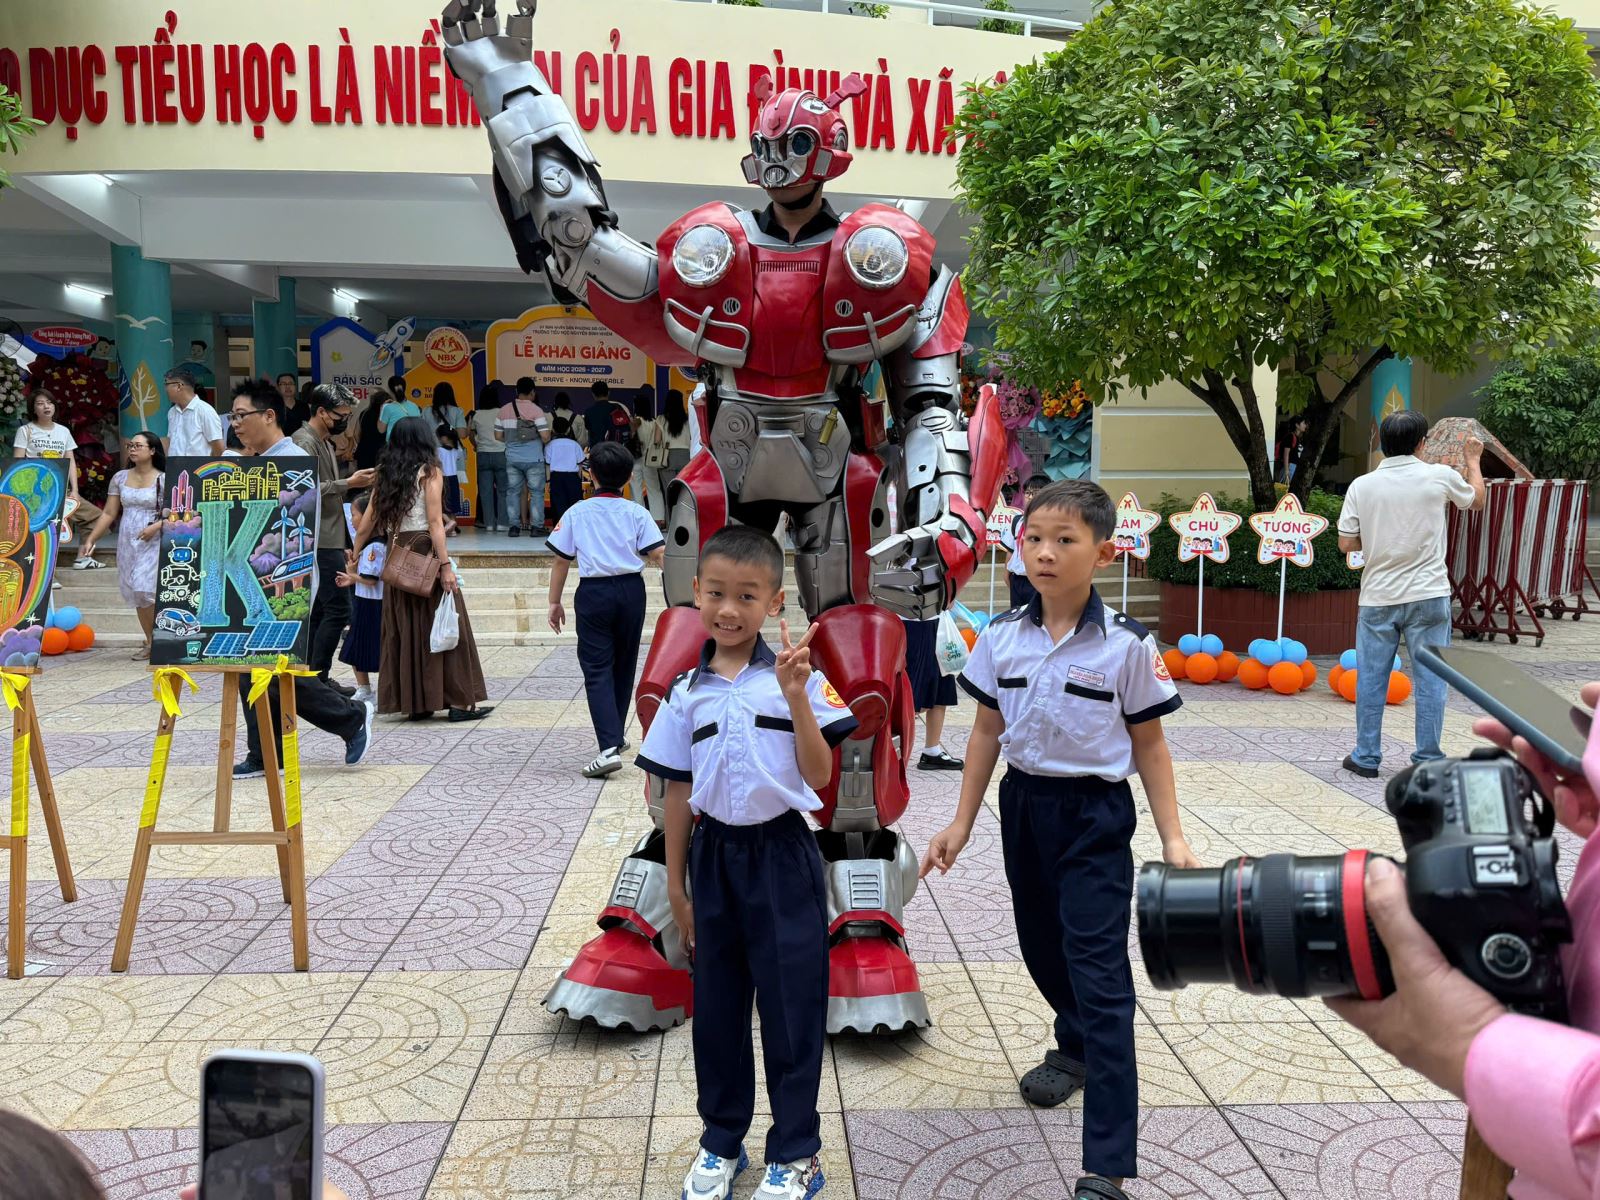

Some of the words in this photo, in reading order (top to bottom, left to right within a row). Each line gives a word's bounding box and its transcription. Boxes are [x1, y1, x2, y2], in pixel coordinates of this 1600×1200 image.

[29, 44, 107, 141] DỤC
[115, 10, 205, 124] TIỂU
[214, 42, 298, 139] HỌC
[308, 27, 362, 124] LÀ
[574, 28, 657, 134] CỦA
[669, 57, 736, 139] GIA
[850, 58, 895, 150] VÀ
[905, 66, 957, 155] XÃ
[514, 336, 534, 358] LỄ
[538, 344, 576, 359] KHAI
[580, 341, 631, 361] GIẢNG
[1188, 517, 1219, 532] CHỦ
[1263, 520, 1311, 535] TƯƠNG
